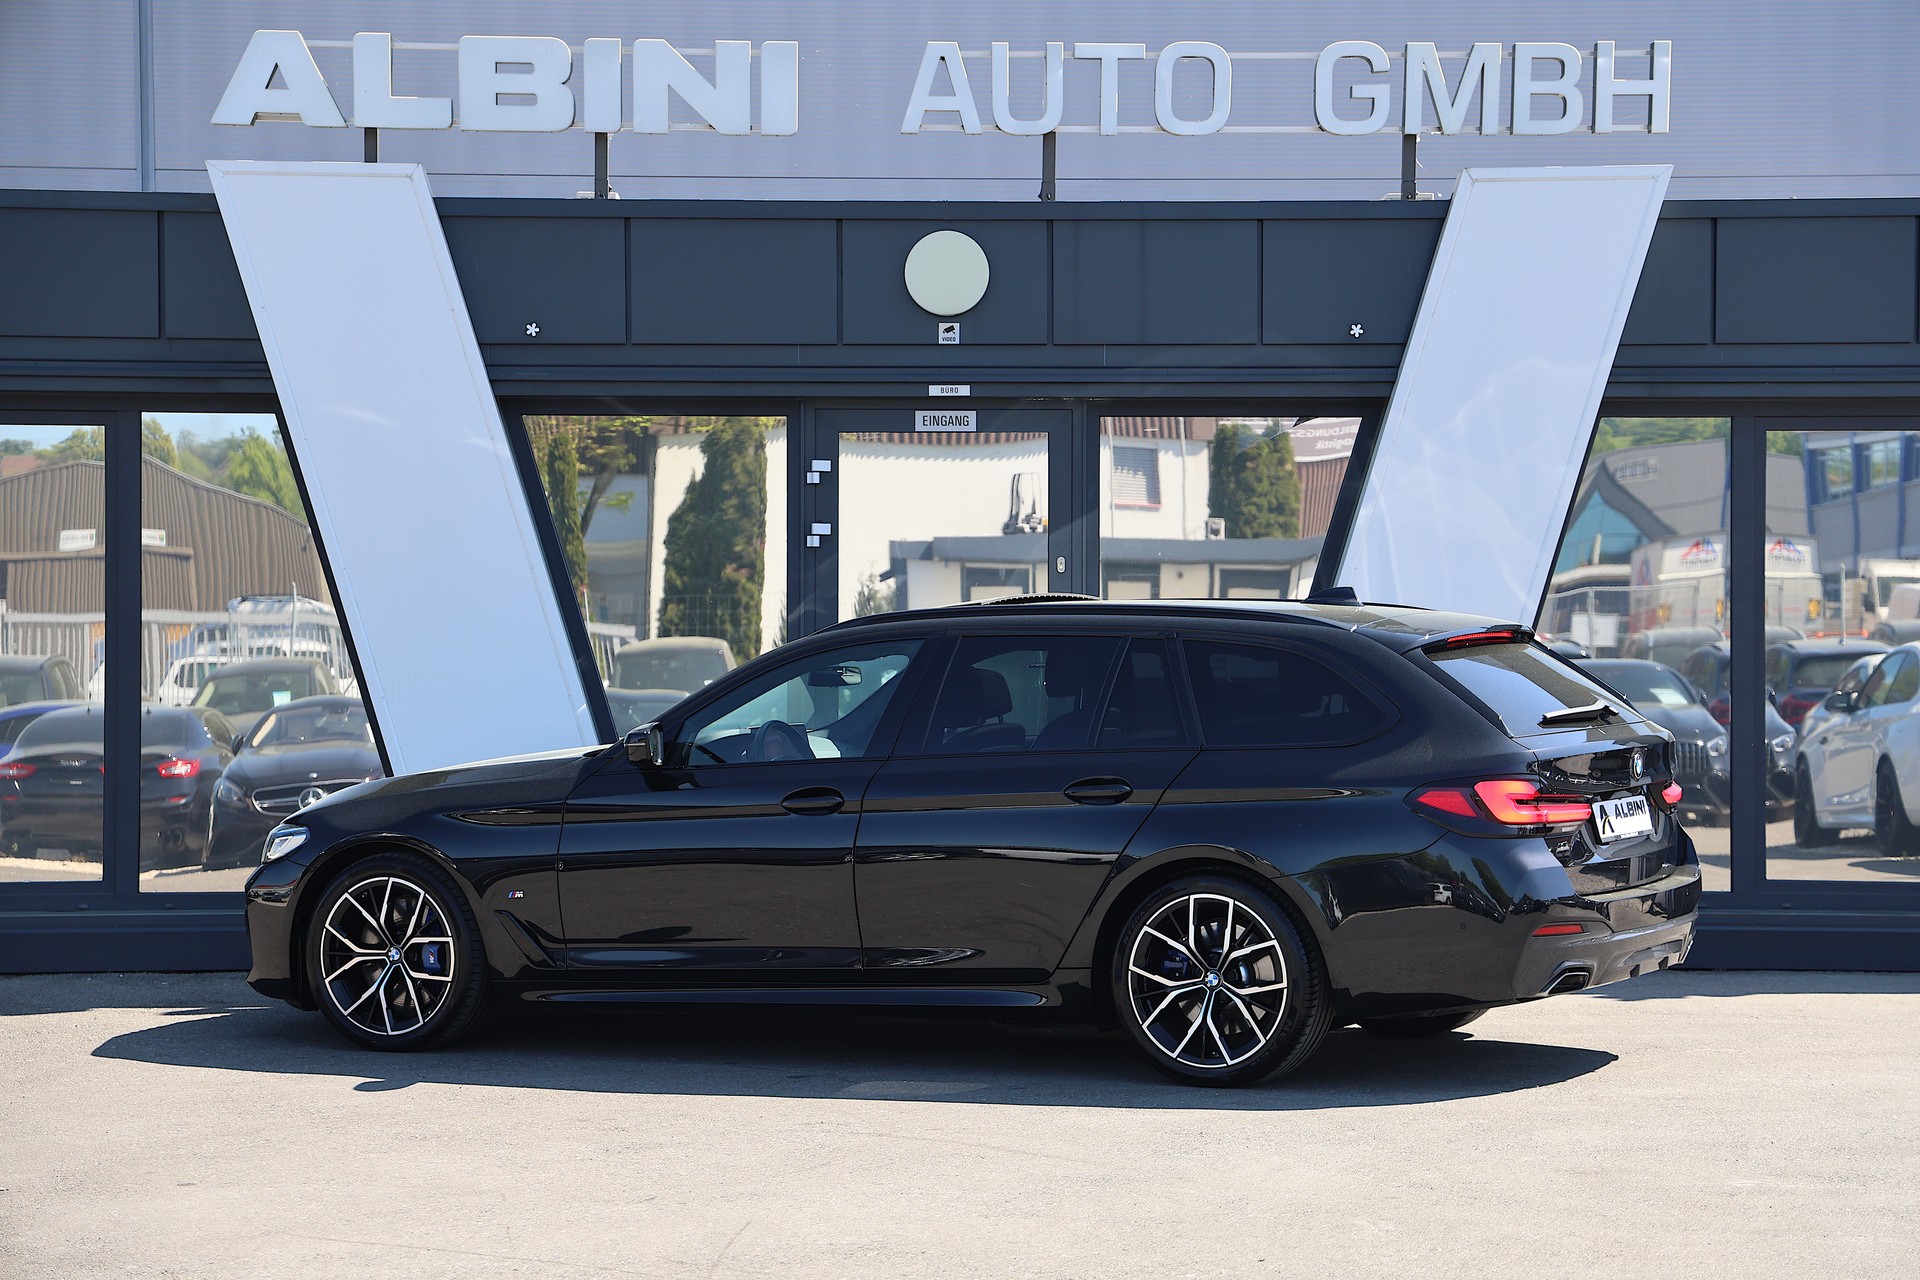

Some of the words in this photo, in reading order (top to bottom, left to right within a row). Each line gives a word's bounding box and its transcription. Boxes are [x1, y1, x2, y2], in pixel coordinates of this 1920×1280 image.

[211, 29, 800, 136] ALBINI
[900, 40, 1233, 136] AUTO
[1313, 39, 1672, 136] GMBH
[940, 386, 959, 394] BÜRO
[922, 415, 970, 427] EINGANG
[1614, 799, 1647, 819] ALBINI
